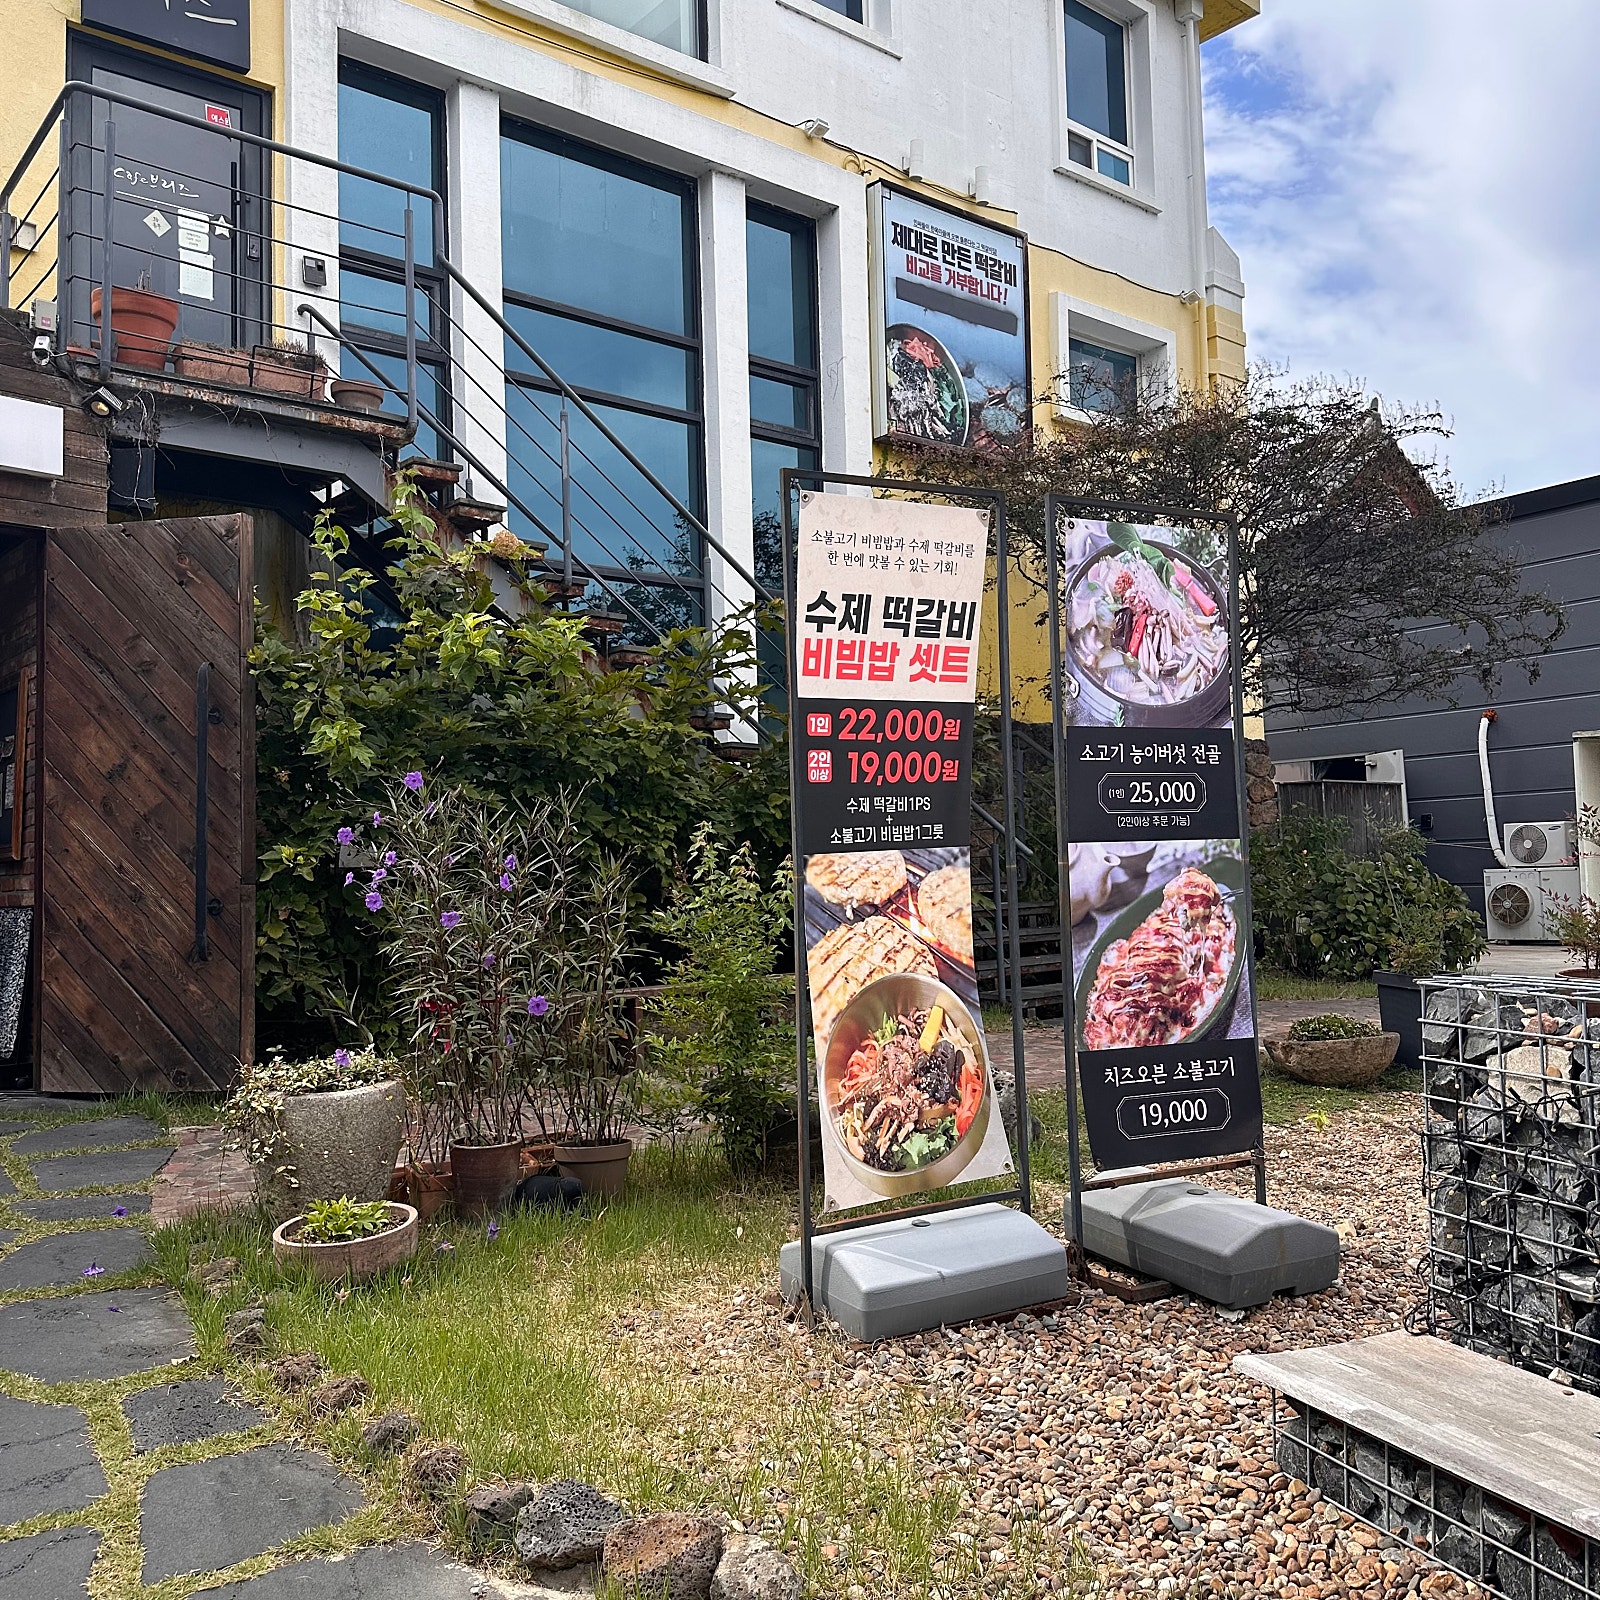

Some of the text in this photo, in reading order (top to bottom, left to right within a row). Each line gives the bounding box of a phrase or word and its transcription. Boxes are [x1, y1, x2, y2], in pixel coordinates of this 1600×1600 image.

[891, 221, 1017, 288] 제대로 만든 떡갈비
[906, 254, 1008, 305] 비교를 거부합니다!
[811, 530, 975, 559] 소불고기 비빔밥과 수제 떡갈비를
[827, 550, 958, 576] 한 번에 맛볼 수 있는 기회!
[804, 590, 977, 640] 수제 떡갈비
[802, 637, 971, 684] 비빔밥 셋트
[809, 717, 829, 733] 1인
[838, 707, 961, 743] 22,000원
[808, 751, 831, 768] 2인
[1079, 743, 1222, 765] 소고기 능이버섯 전골
[810, 768, 829, 781] 이상
[847, 751, 959, 786] 19,000원
[846, 796, 931, 814] 수제 떡갈비1PS
[1108, 781, 1196, 807] (1인) 25,000
[830, 823, 944, 844] 소불고기 비빔밥1그릇
[1117, 815, 1191, 828] (2인이상 주문 가능)
[1104, 1056, 1235, 1087] 치즈오븐 소불고기
[1138, 1098, 1208, 1128] 19,000
